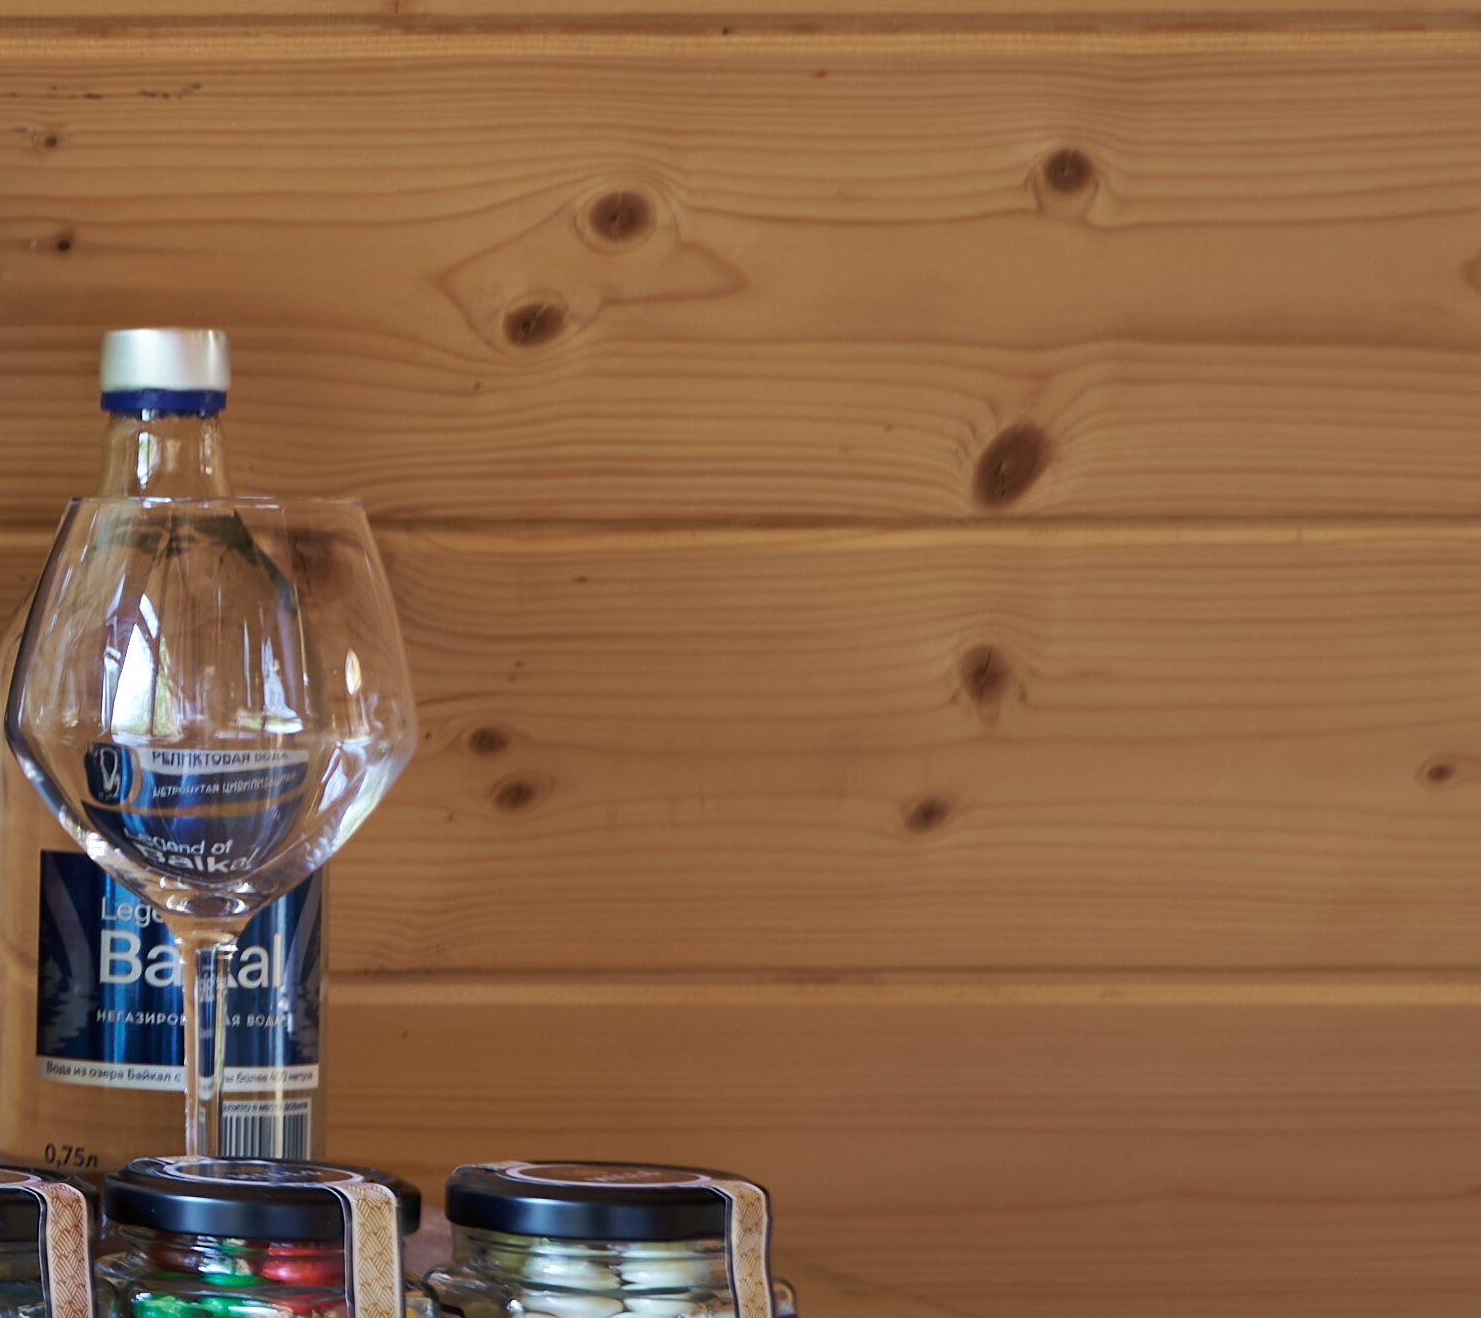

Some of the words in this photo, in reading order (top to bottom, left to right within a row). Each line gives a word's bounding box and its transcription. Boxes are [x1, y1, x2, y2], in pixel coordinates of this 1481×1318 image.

[210, 839, 234, 855] of
[100, 896, 166, 928] Leg
[99, 929, 282, 989] Baal
[44, 1143, 98, 1168] 0,75л
